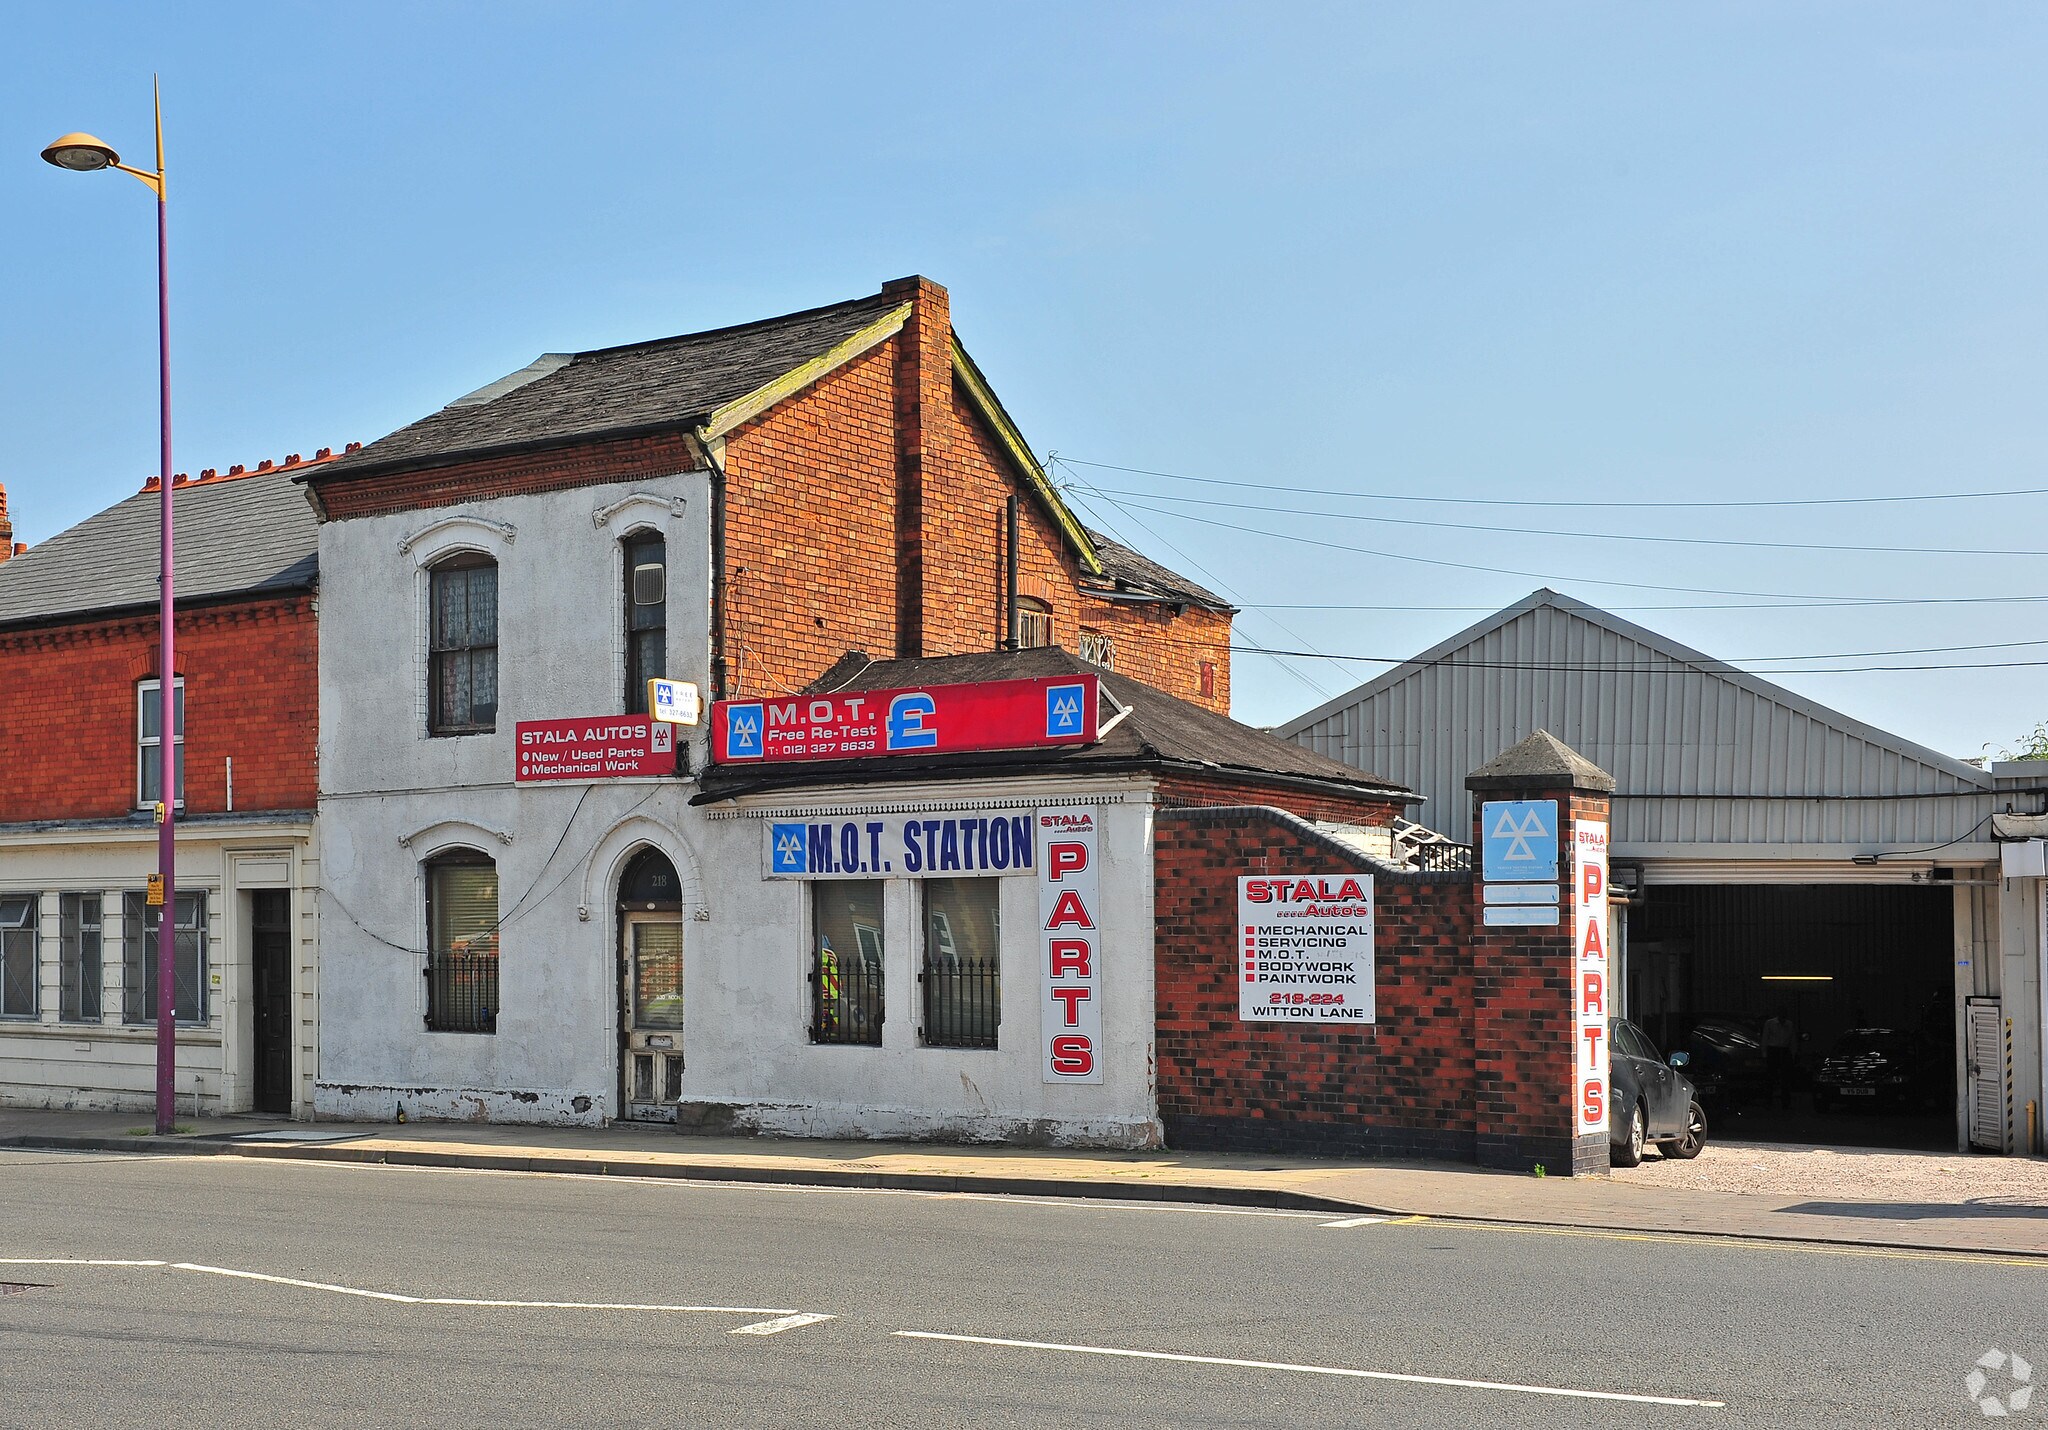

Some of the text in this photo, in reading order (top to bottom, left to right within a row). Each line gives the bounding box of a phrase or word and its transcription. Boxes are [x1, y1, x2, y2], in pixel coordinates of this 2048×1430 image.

[768, 698, 875, 727] M.O.T.
[521, 725, 647, 745] STALA AUTO'S
[768, 725, 877, 742] Free Re-Test
[531, 747, 645, 763] New / Used Parts
[768, 740, 875, 755] T: 0121 327 8633
[531, 760, 639, 775] Mechanical Work
[1040, 814, 1093, 828] STALA
[807, 815, 1034, 875] M.O.T. STATION
[1578, 831, 1605, 846] STALA
[652, 874, 667, 887] 218
[1246, 878, 1368, 903] STALA
[1258, 925, 1368, 936] MECHANICAL
[1258, 937, 1347, 948] SERVICING
[1044, 841, 1097, 1076] PARTS
[1258, 949, 1310, 960] M.O.T.
[1258, 961, 1354, 972] BODYWORK
[1258, 974, 1357, 985] PAINTWORK
[1269, 992, 1345, 1006] 218-224
[1580, 861, 1606, 1126] PARTS
[1253, 1006, 1364, 1018] WITTON LANE
